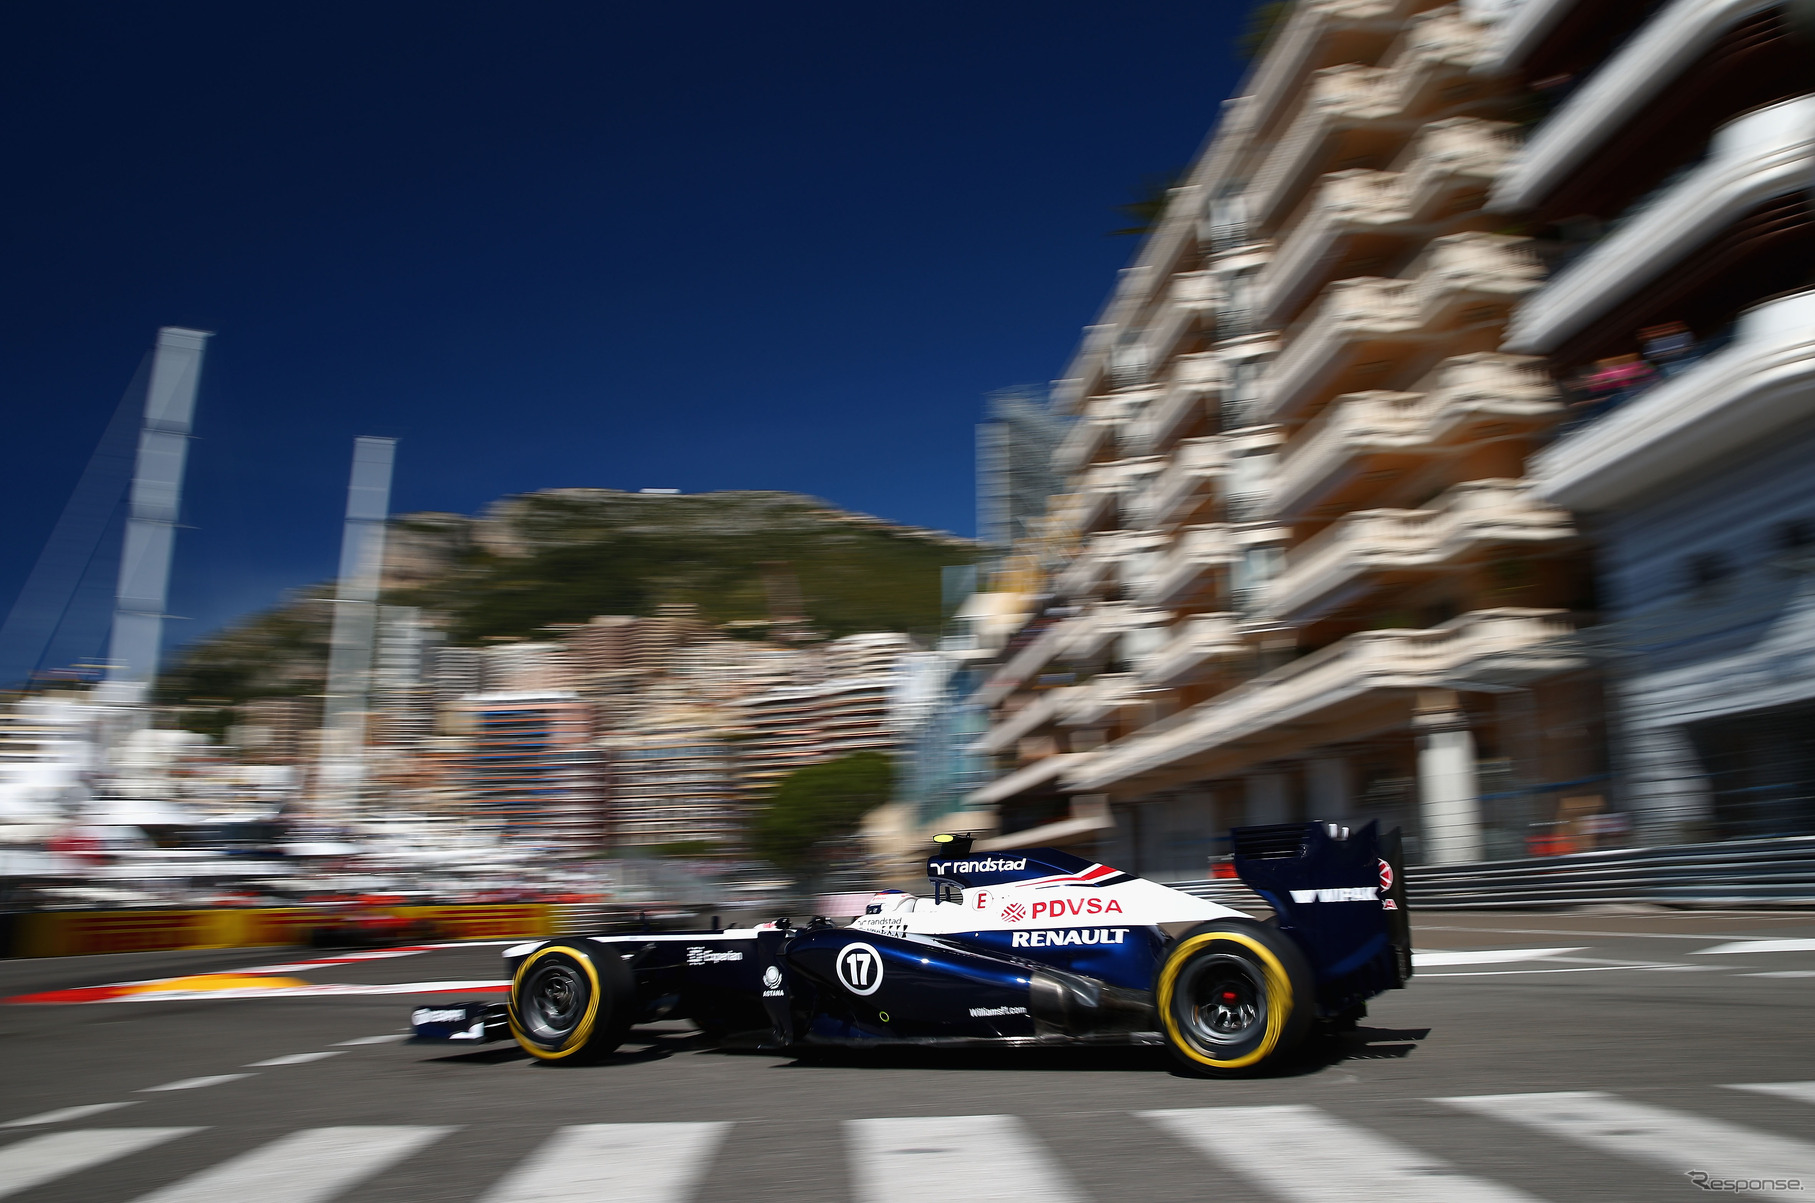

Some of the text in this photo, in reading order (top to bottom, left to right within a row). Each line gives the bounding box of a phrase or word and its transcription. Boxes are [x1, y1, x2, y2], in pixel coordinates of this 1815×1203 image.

[953, 858, 1027, 874] randstad
[977, 893, 987, 909] E
[1032, 898, 1123, 919] PDVSA
[868, 917, 902, 926] randstad
[1012, 928, 1130, 947] RENAULT
[846, 953, 871, 985] 17
